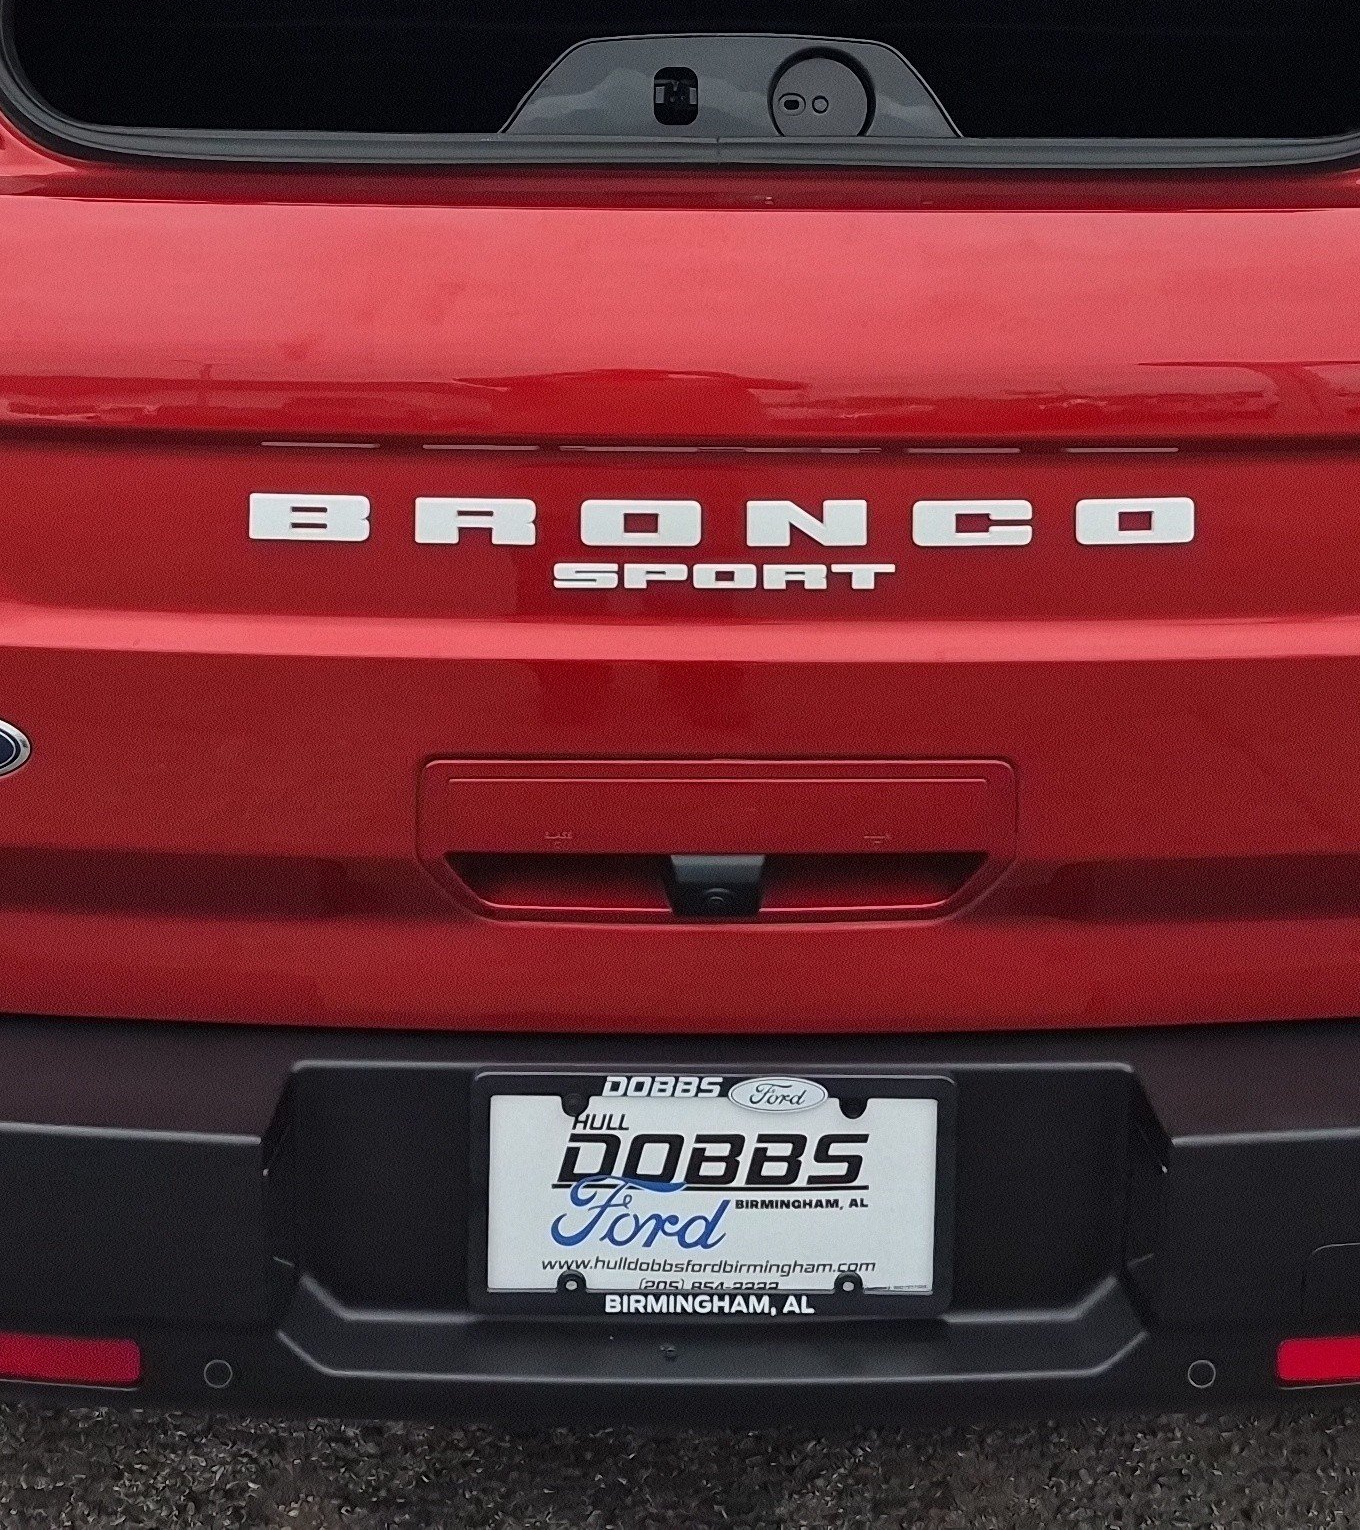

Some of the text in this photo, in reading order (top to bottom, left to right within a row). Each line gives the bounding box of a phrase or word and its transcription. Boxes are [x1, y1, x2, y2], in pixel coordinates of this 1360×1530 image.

[248, 491, 1195, 547] BRONCO
[552, 561, 896, 590] SPORT
[602, 1075, 807, 1107] DOBBS Ford
[571, 1113, 630, 1131] HULL
[557, 1133, 870, 1186] DOBBS
[551, 1175, 732, 1249] Ford
[735, 1197, 869, 1210] BIRMINGHAM, AL
[541, 1256, 876, 1277] www.hulldobbsfordbirmingham.com
[604, 1294, 815, 1317] BIRMINGHAM, AL
